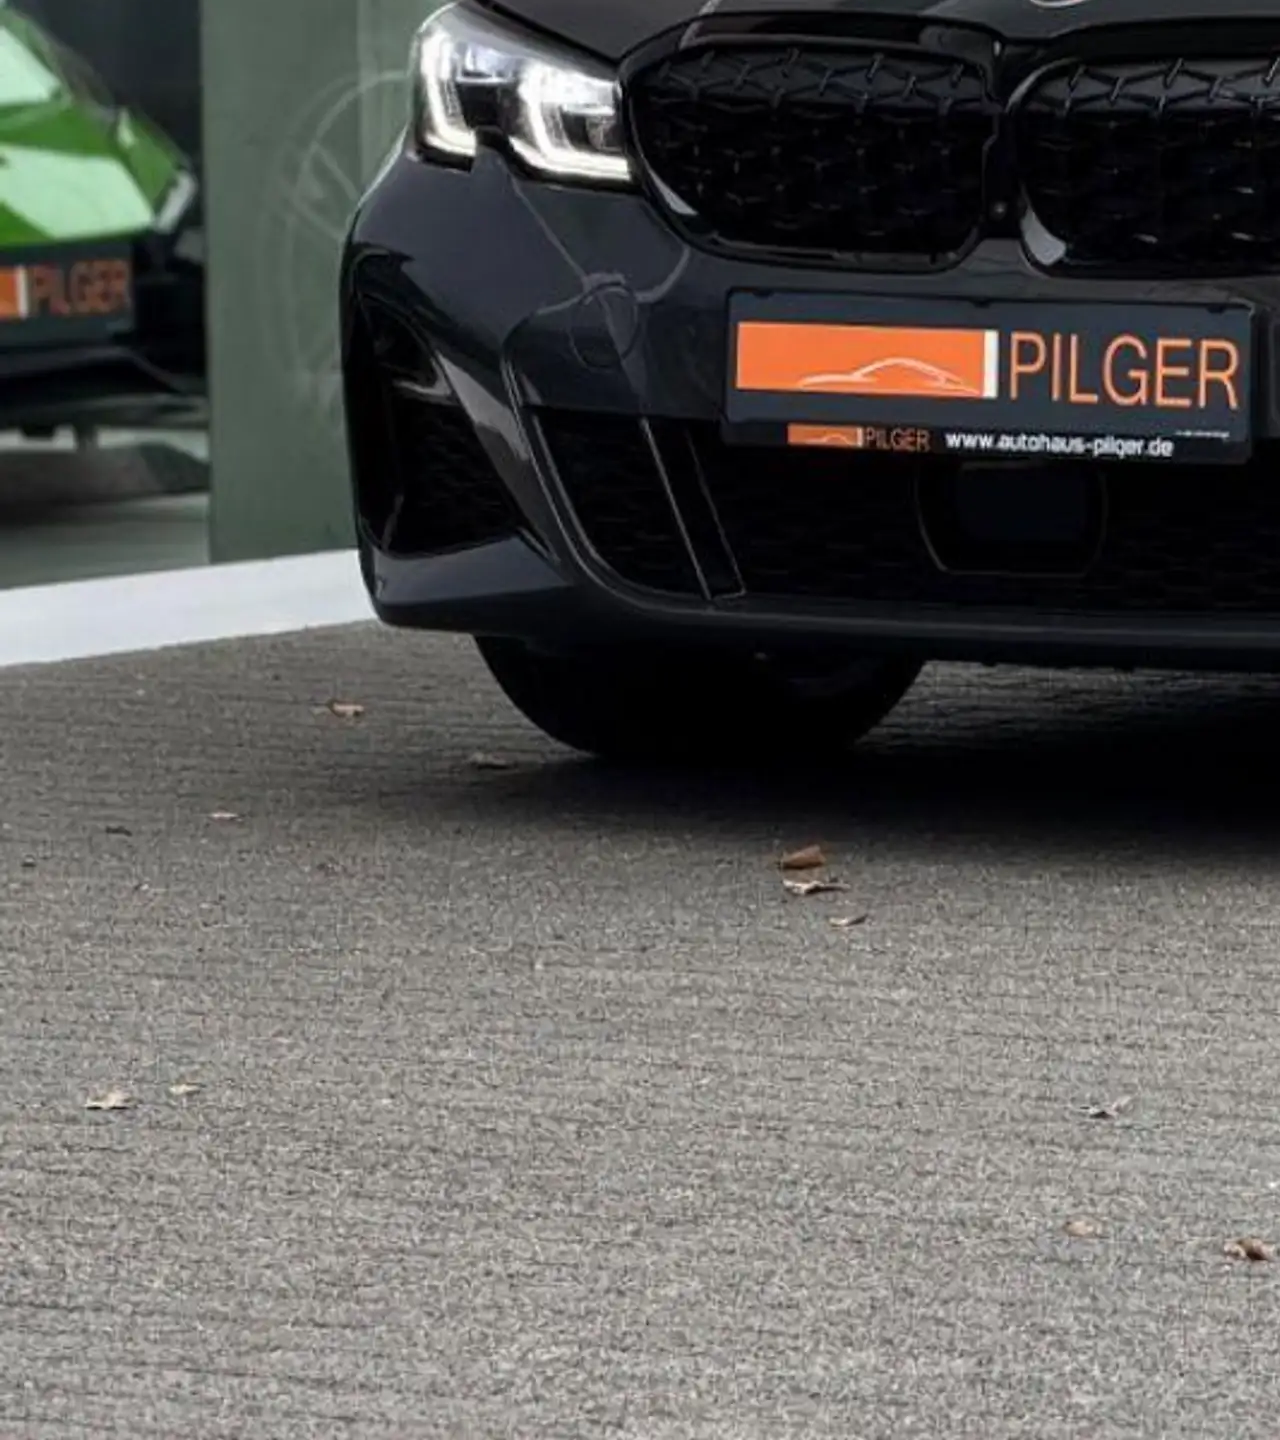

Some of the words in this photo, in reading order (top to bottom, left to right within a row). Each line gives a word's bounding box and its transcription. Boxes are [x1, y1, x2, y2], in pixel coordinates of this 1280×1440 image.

[1009, 331, 1239, 409] PILGER
[865, 427, 930, 452] PILGER
[945, 432, 1174, 458] www.autohaus-pilger.de
